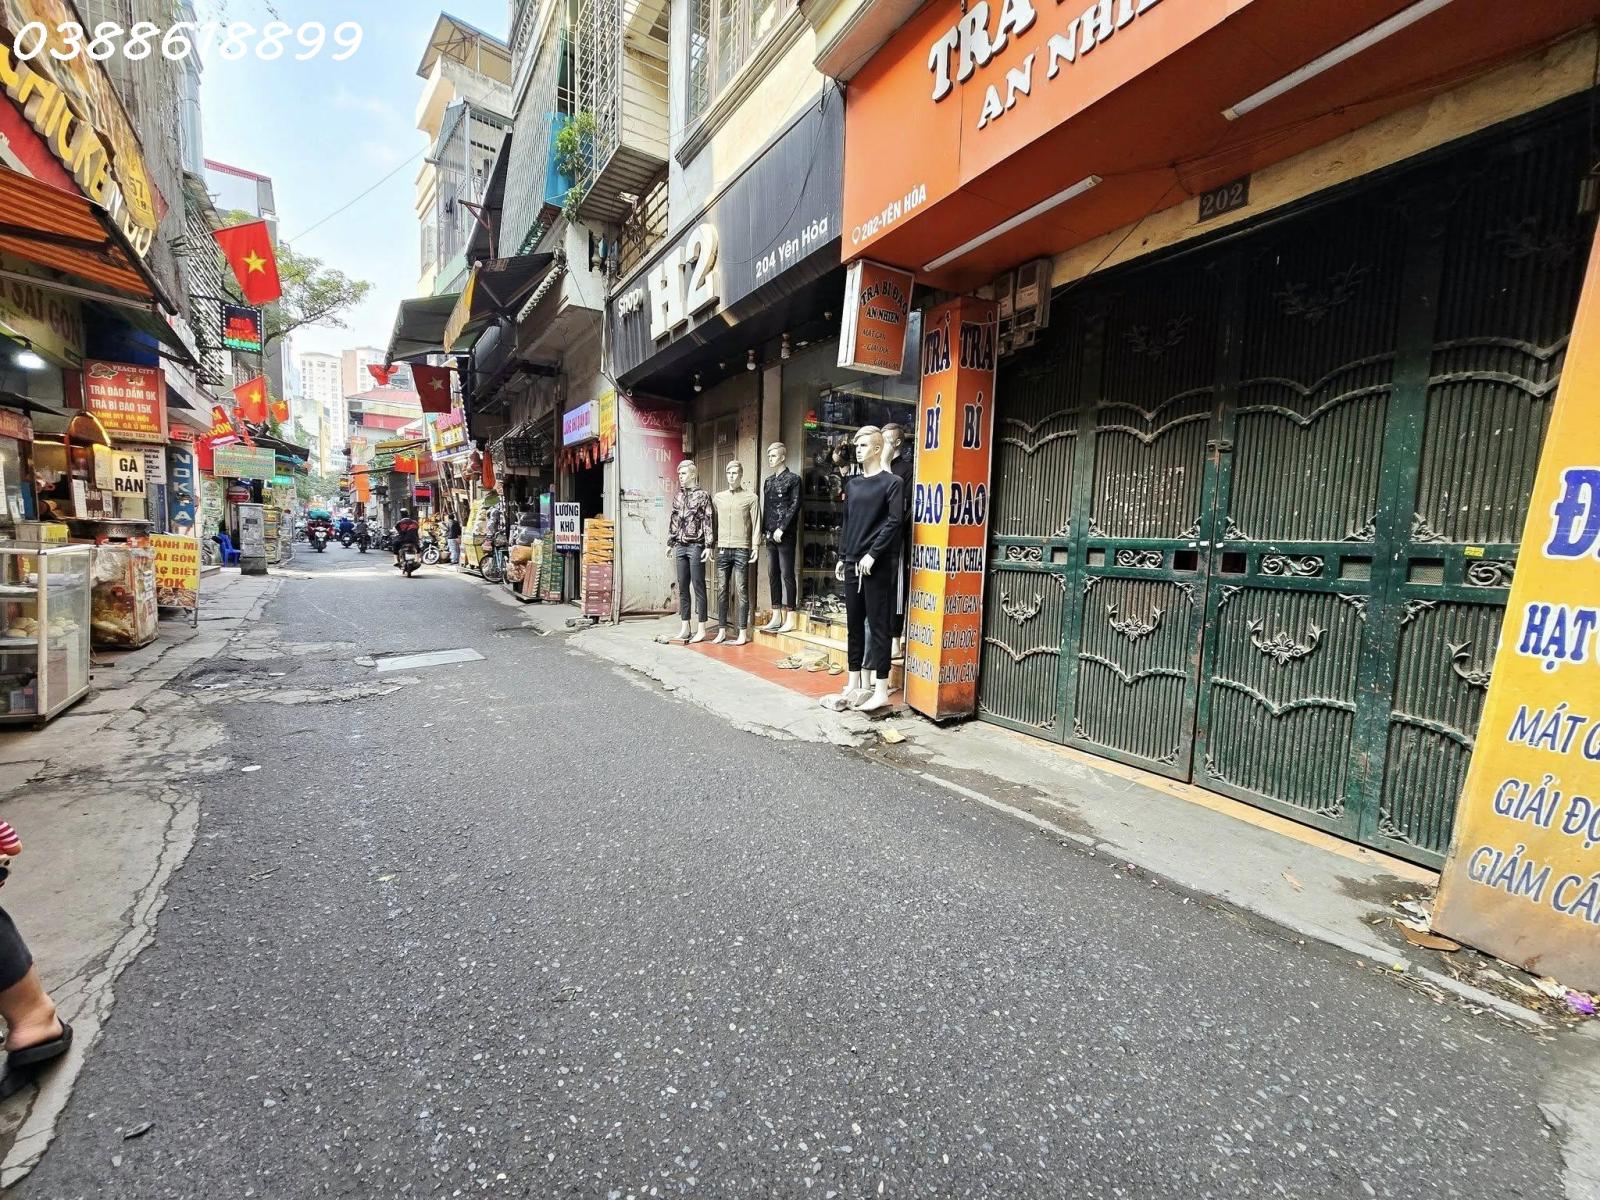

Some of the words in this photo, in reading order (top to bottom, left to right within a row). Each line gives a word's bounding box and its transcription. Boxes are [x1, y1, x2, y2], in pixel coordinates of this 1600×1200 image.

[976, 53, 1035, 129] AN
[1046, 0, 1163, 79] NHI
[903, 183, 927, 214] HÒA
[1202, 183, 1244, 216] 202
[755, 250, 776, 278] 204
[778, 238, 799, 262] Yên
[801, 217, 828, 247] Hòa
[648, 223, 719, 341] H2
[90, 384, 105, 394] TRÀ
[91, 398, 107, 409] TRÀ
[137, 404, 152, 413] 15K
[925, 394, 942, 451] BÍ
[962, 391, 984, 450] BÍ
[119, 456, 138, 472] GÀ
[114, 476, 144, 493] RÁN
[555, 504, 579, 516] LƯƠNG
[914, 481, 944, 525] ĐAO
[949, 481, 988, 526] ĐAO
[1547, 469, 1600, 558] Đ
[560, 518, 575, 532] KHÔ
[925, 546, 941, 571] CHIA
[945, 547, 963, 579] HẠT
[964, 547, 983, 572] CHIA
[156, 578, 186, 589] 20K
[944, 592, 962, 615] MÁT
[963, 595, 980, 614] GAN
[943, 625, 959, 649] GIẢI
[959, 626, 977, 653] ĐỘC
[1519, 604, 1597, 671] HẠT
[1508, 702, 1587, 753] MÁT
[1495, 776, 1561, 827] GIẢI
[1469, 844, 1551, 903] GIẢM
[1552, 872, 1600, 924] CÂ
